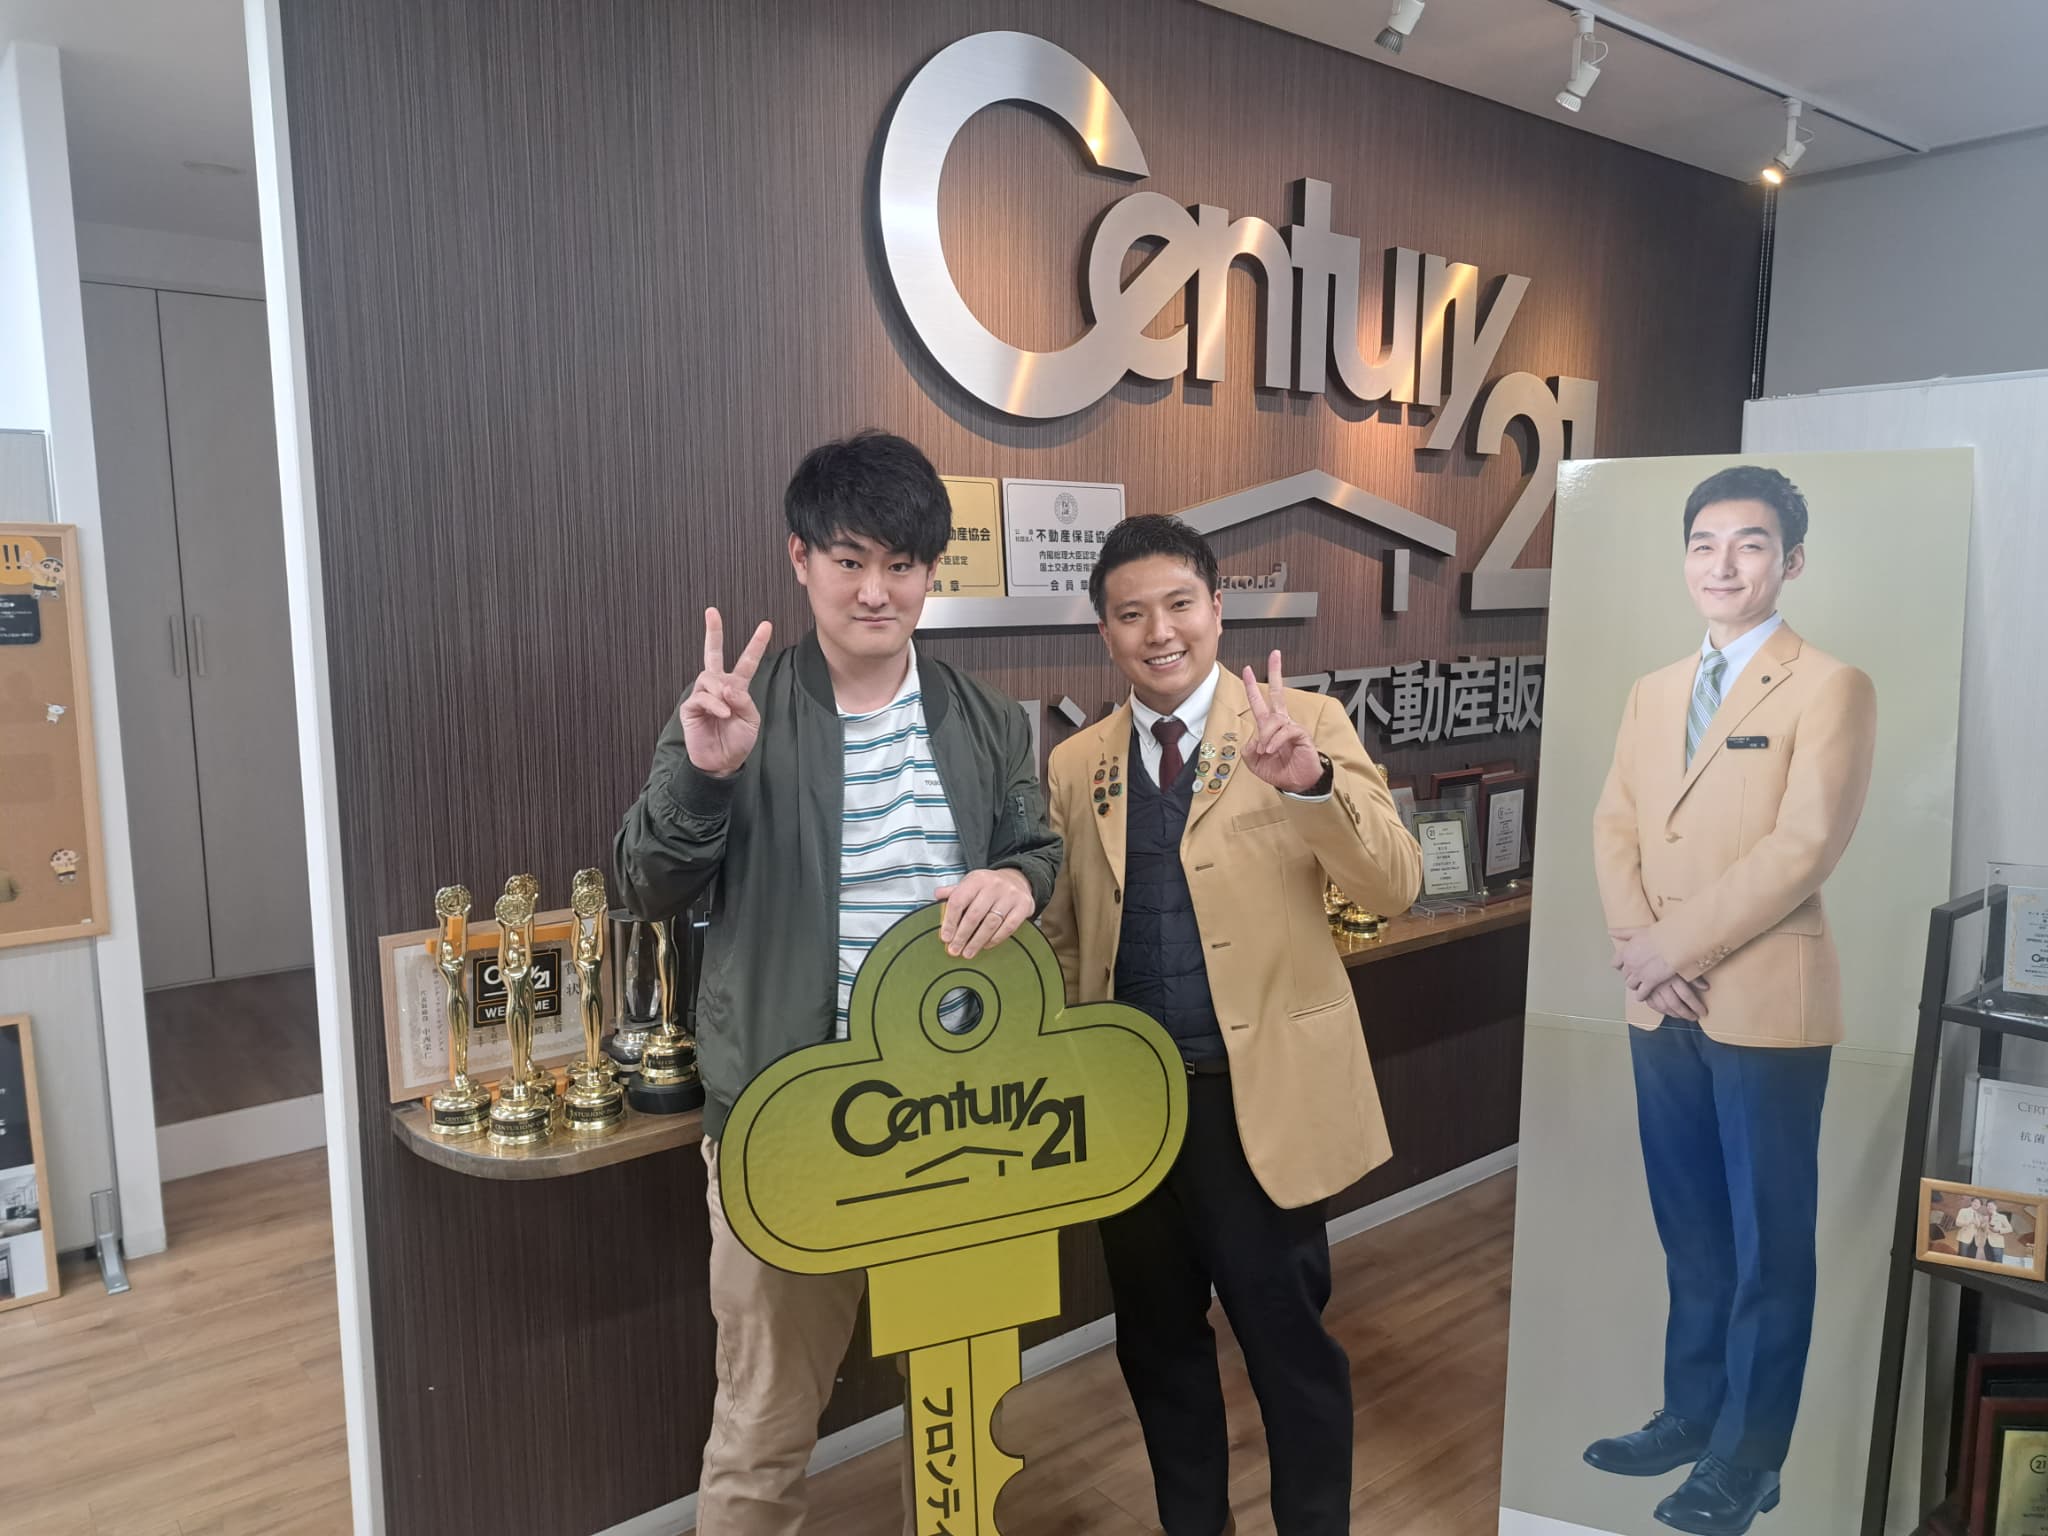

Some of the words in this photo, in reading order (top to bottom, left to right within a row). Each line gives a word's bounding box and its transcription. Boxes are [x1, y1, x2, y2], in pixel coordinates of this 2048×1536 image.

[880, 31, 1531, 450] Century
[1036, 528, 1110, 543] 不動産保証協
[534, 970, 550, 989] 21
[484, 999, 550, 1019] WEME
[831, 1077, 1048, 1157] Century
[1027, 1095, 1088, 1171] 21
